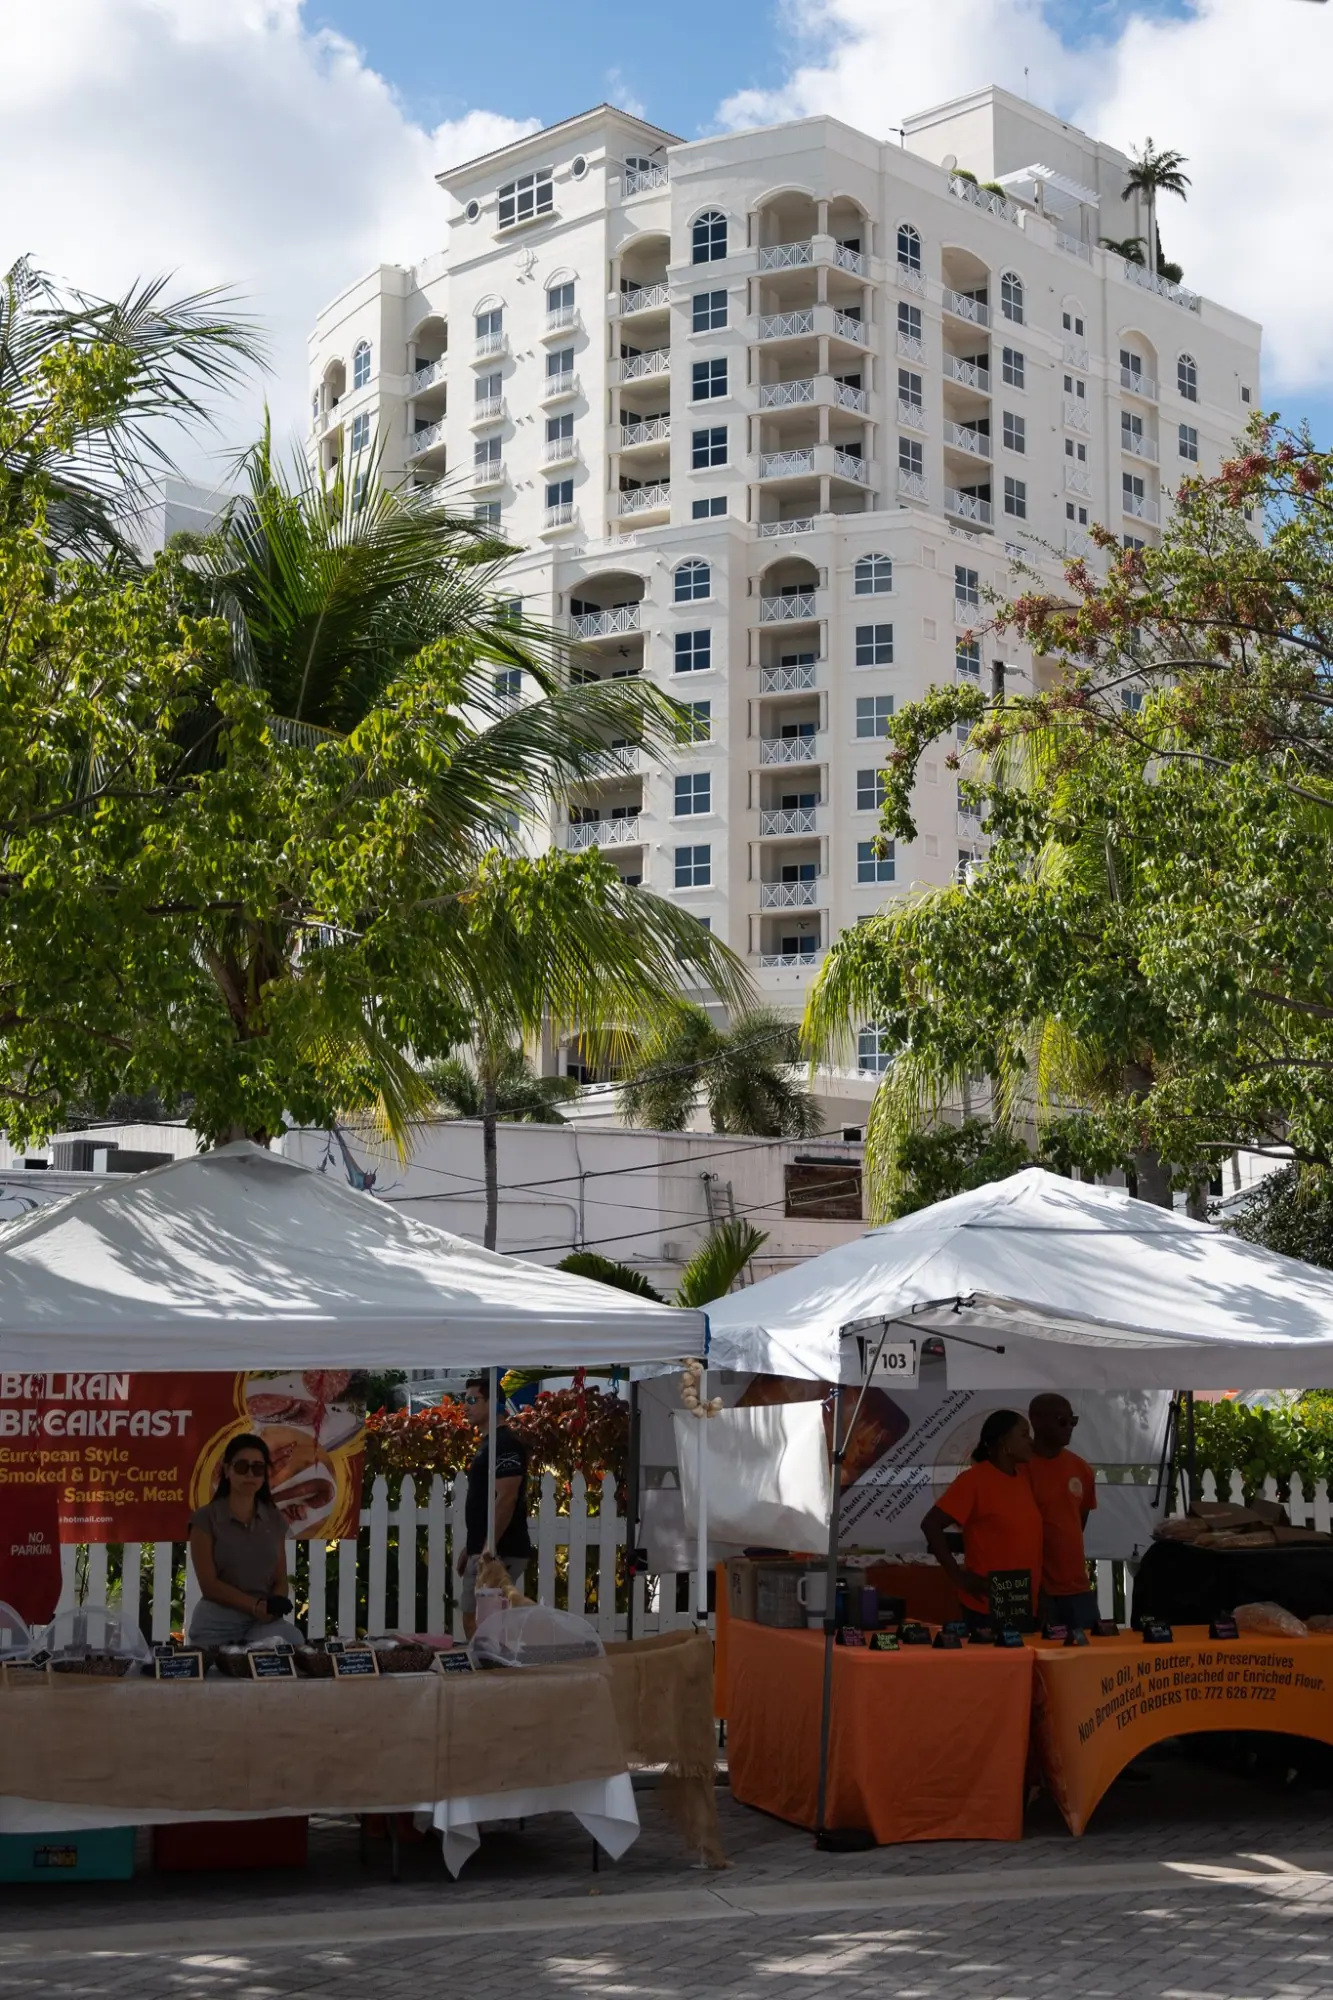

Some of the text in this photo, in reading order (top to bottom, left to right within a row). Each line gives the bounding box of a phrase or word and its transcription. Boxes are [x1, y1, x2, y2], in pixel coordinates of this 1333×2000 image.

[882, 1353, 906, 1369] 103
[0, 1373, 130, 1401] BALKAN
[0, 1408, 192, 1437] BREAKFAST
[938, 1393, 972, 1428] Enriched
[0, 1446, 129, 1466] European Style
[0, 1466, 178, 1486] Smoked & Dry-Cured
[143, 1486, 184, 1503] Meat
[873, 1498, 893, 1519] Text
[890, 1486, 902, 1500] To
[885, 1508, 901, 1523] 772
[28, 1531, 44, 1543] NO
[1101, 1652, 1294, 1696] No Oil, No Butter, No Preservatives
[1078, 1670, 1326, 1744] Non Bromated, Non Bleached or Enriched Flour.
[1115, 1686, 1276, 1730] TEXT ORDERS TO: 772 626 7722
